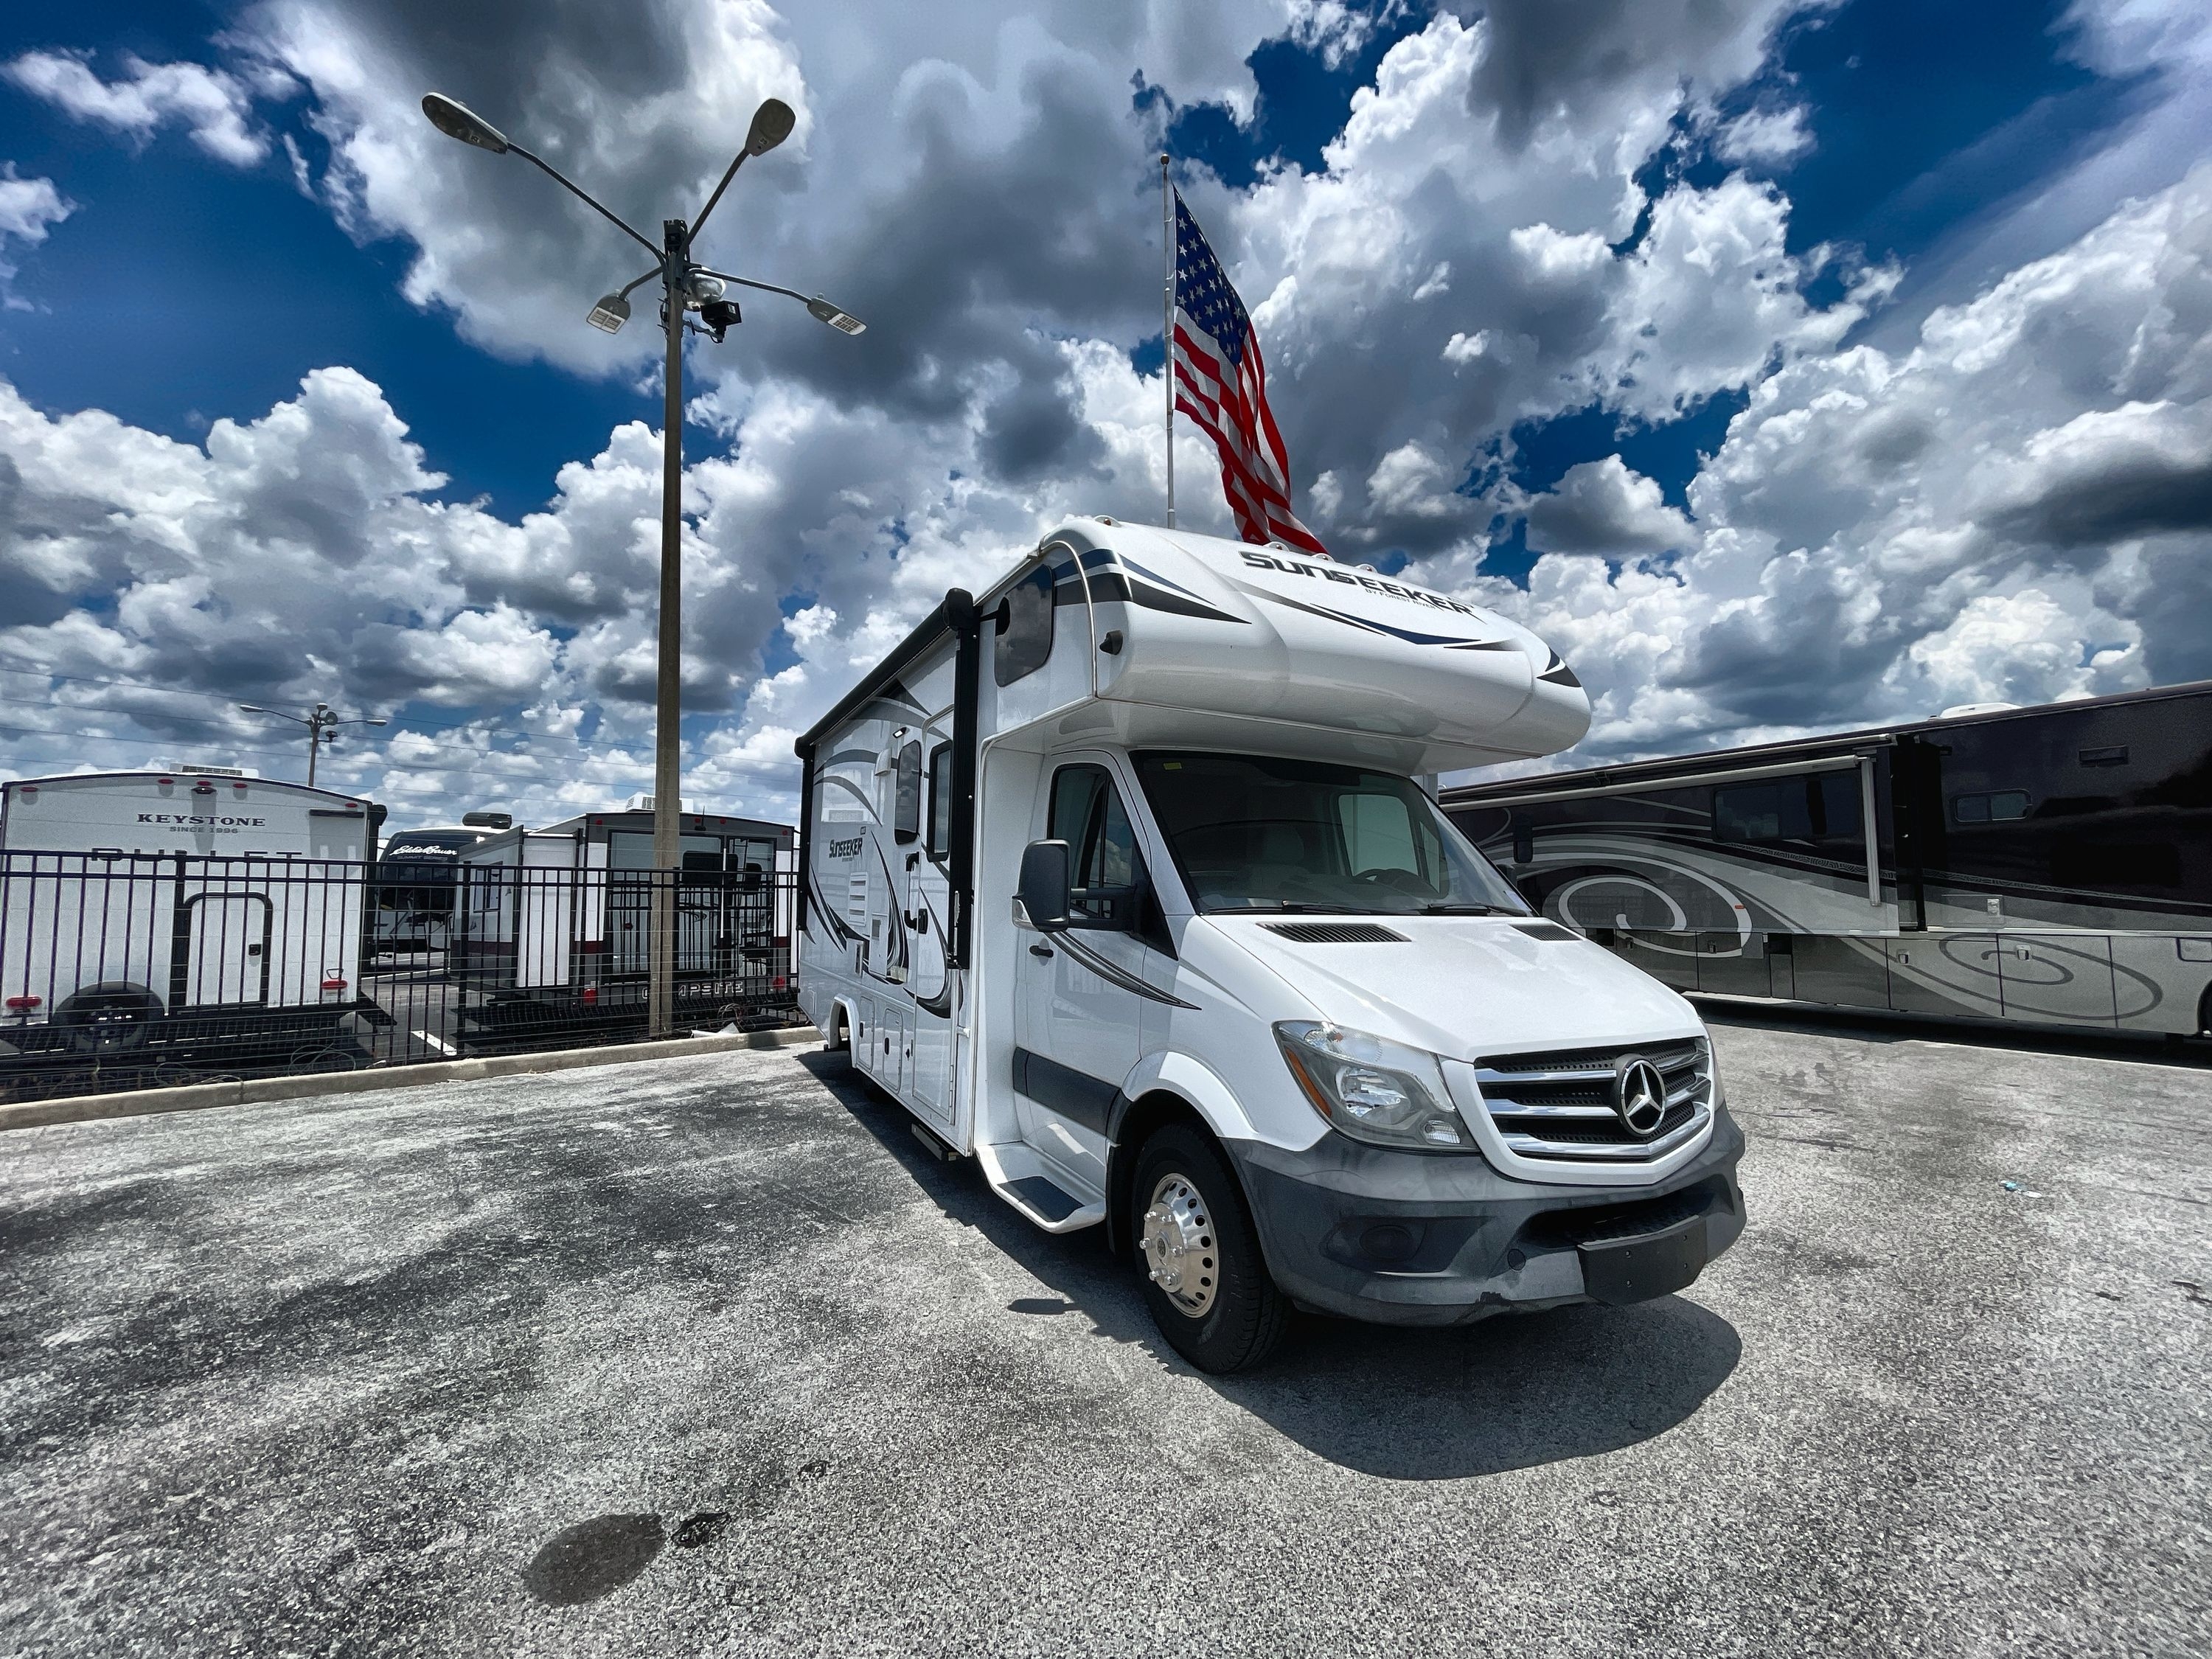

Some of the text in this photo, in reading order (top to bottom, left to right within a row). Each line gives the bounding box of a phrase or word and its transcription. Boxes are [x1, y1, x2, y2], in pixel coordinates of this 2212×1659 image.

[1380, 591, 1411, 602] FOREST
[1412, 599, 1436, 610] RIVER
[136, 813, 266, 827] KEYSTONE
[389, 845, 457, 856] Eddie Bauer
